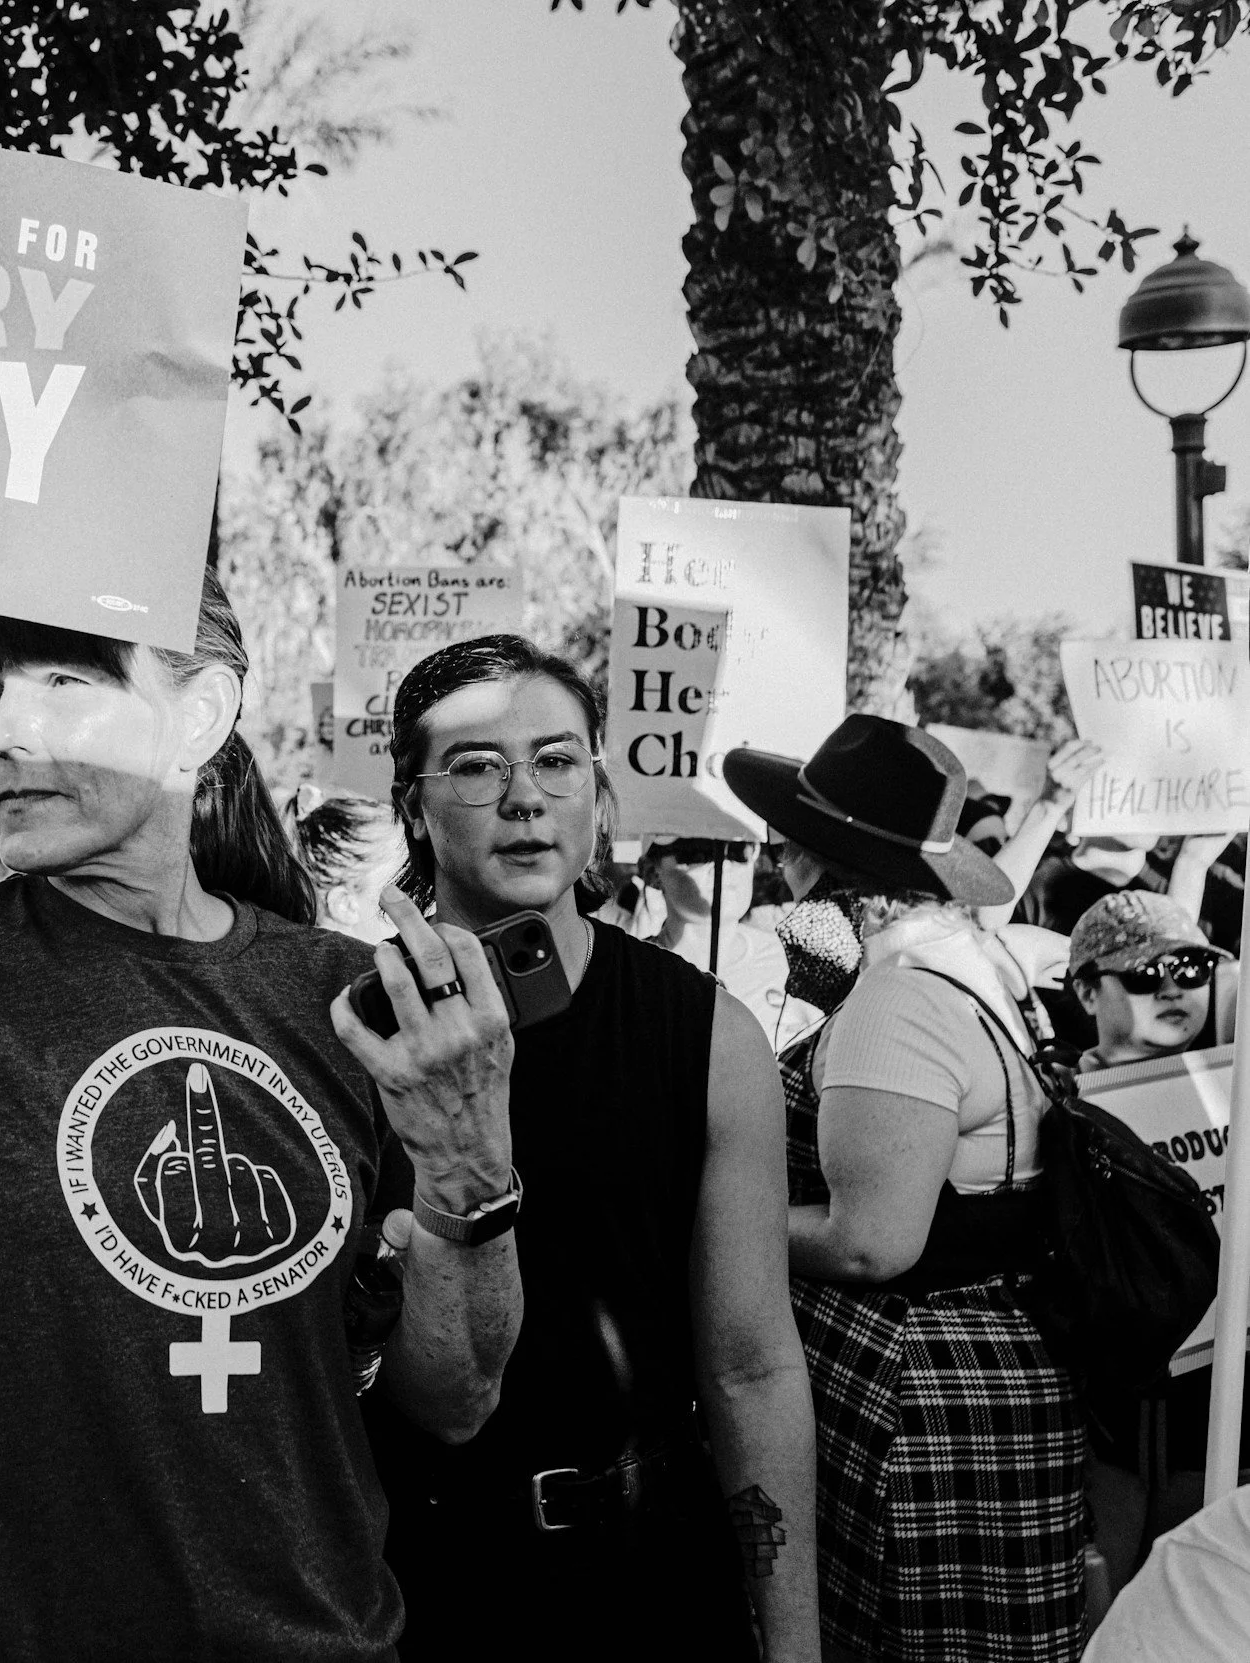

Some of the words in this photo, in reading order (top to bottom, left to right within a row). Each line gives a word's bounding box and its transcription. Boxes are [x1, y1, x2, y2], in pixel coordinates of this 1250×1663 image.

[17, 217, 98, 271] FOR
[344, 570, 422, 588] Abortion
[428, 569, 469, 588] Bans
[637, 542, 737, 589] Her
[371, 592, 469, 617] SEXIST
[1164, 571, 1195, 608] WE
[632, 606, 766, 665] Bod
[1140, 604, 1224, 640] BELIEVE
[1094, 656, 1237, 703] ABORTION
[1165, 719, 1191, 754] IS
[1089, 767, 1250, 820] HEALTHCARE
[94, 1053, 133, 1086] THE
[131, 1035, 270, 1084] GOVERNMENT
[271, 1070, 288, 1095] IN
[65, 1085, 102, 1162] WANTED
[287, 1095, 315, 1123] MY
[311, 1124, 349, 1201] UTERUS
[69, 1178, 89, 1194] IF
[94, 1224, 117, 1252] I'D
[112, 1248, 158, 1295] HAVE
[236, 1288, 250, 1305] A
[252, 1240, 330, 1300] SENATOR
